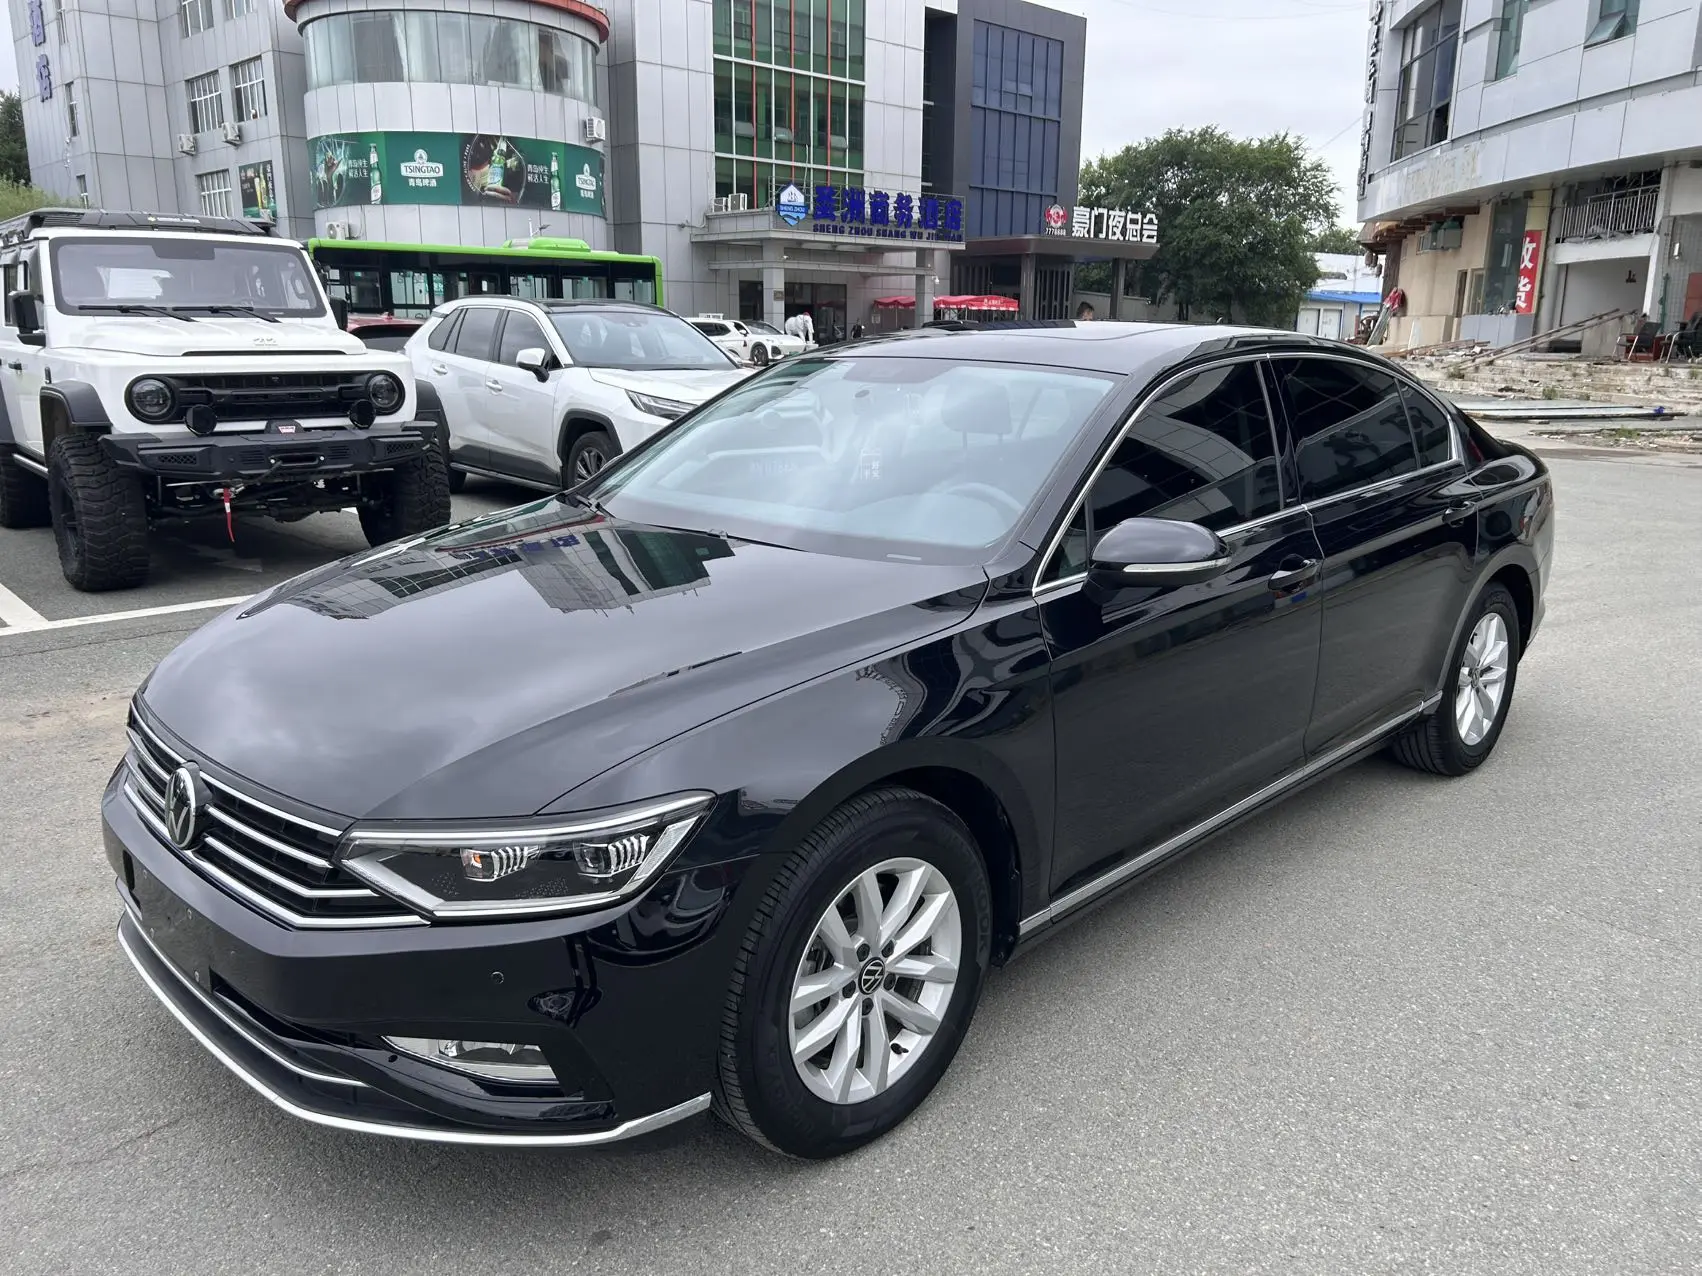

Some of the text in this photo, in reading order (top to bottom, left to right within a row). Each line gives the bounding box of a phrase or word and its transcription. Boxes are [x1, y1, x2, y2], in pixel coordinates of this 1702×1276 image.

[404, 165, 440, 175] TSINGTAO
[812, 223, 846, 235] SHENG
[848, 226, 873, 237] ZHOU
[876, 228, 907, 239] SHANG
[910, 230, 923, 240] WU
[1072, 206, 1159, 244] 豪门夜总会
